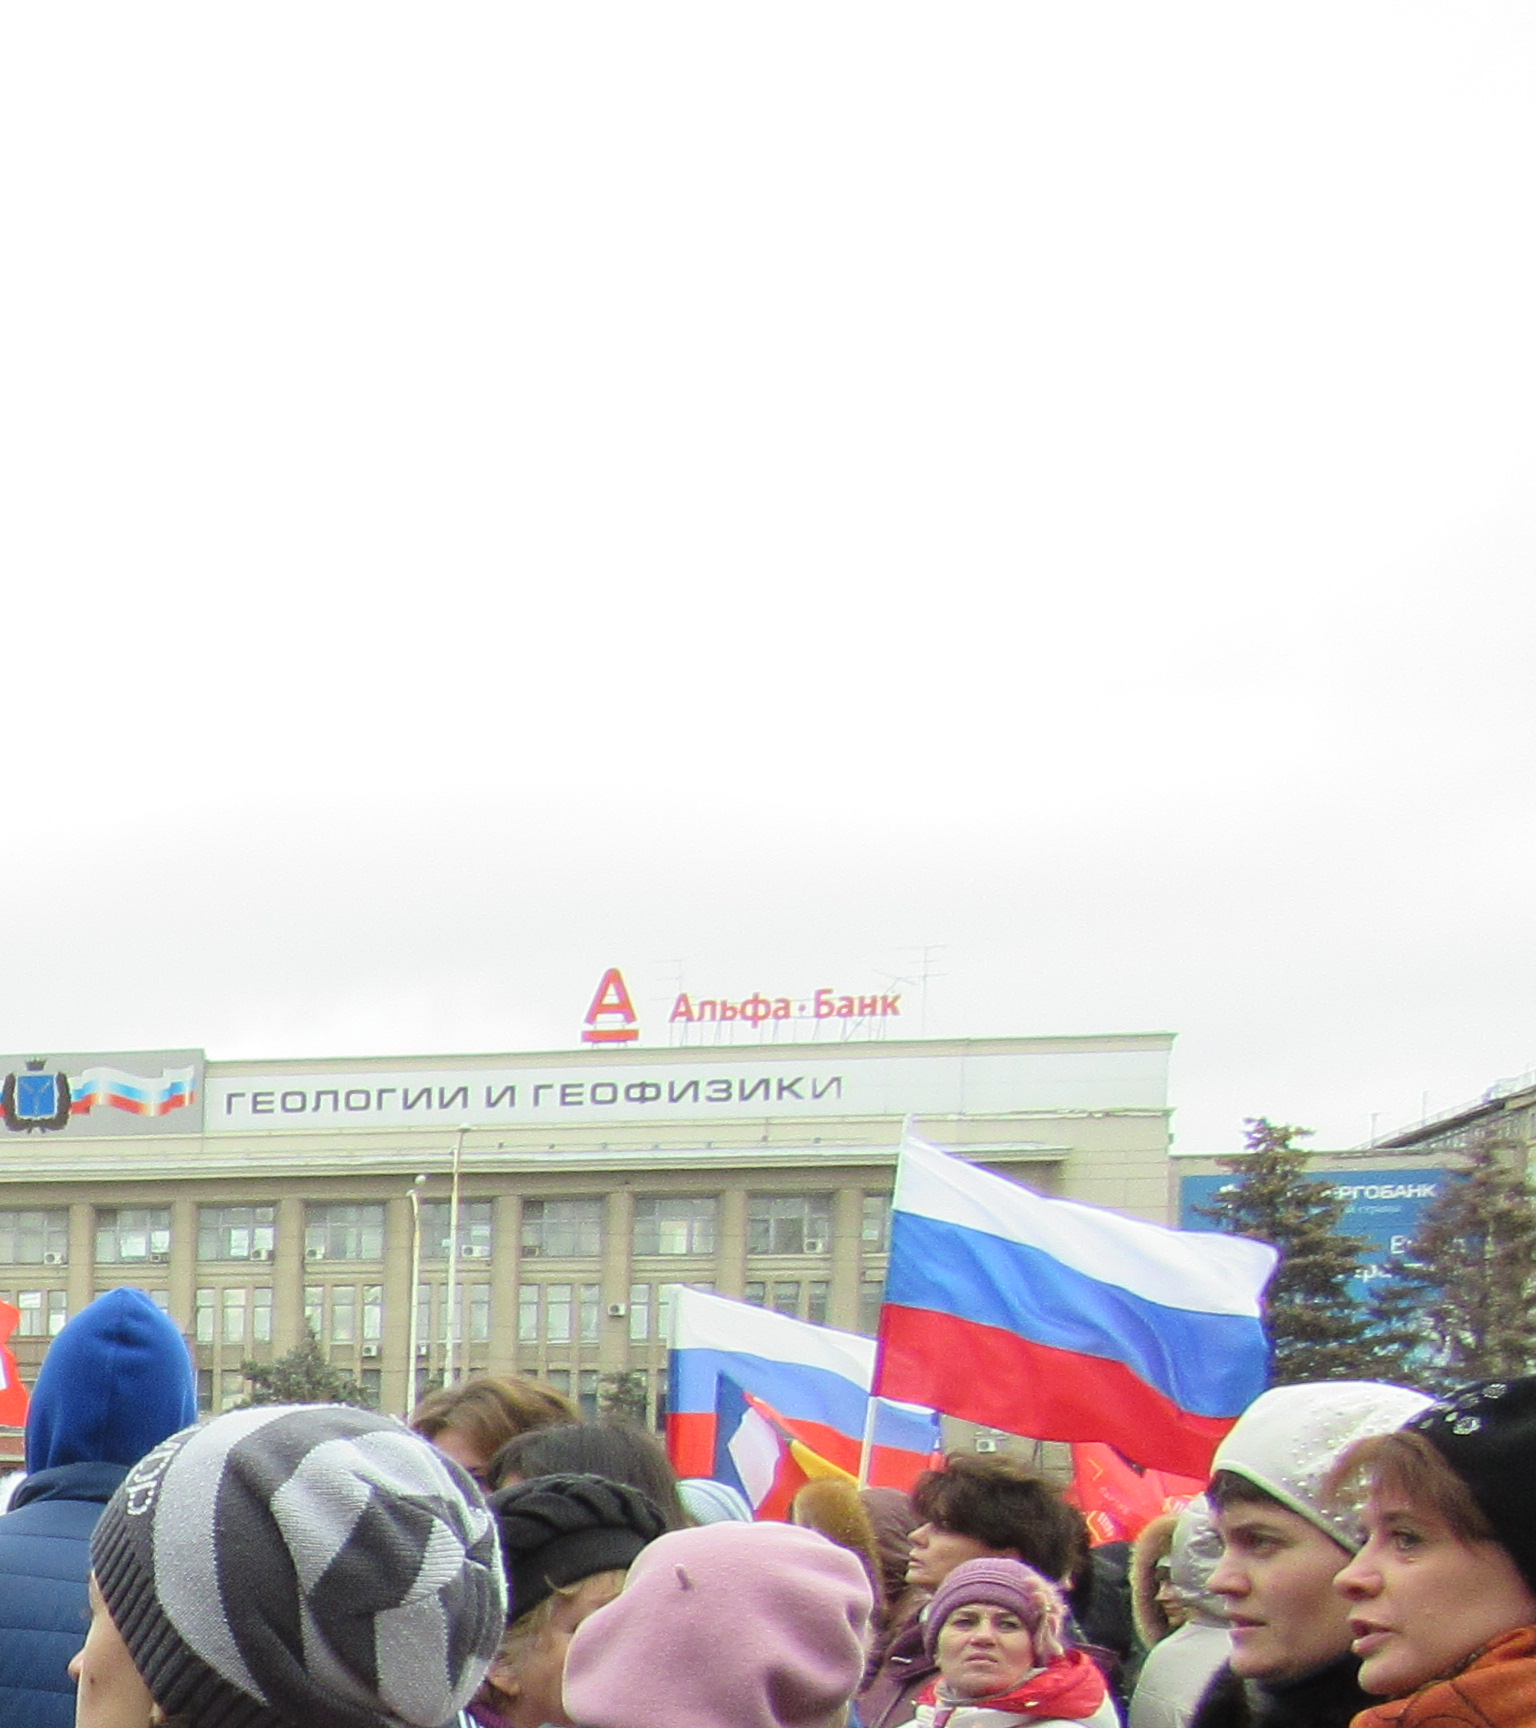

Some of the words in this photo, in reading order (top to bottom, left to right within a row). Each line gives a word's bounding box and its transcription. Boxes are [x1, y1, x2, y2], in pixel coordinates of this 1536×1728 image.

[226, 1085, 469, 1115] ГЕОЛОГИИ
[485, 1084, 516, 1109] И
[533, 1076, 843, 1108] ГЕОФИЗИКИ
